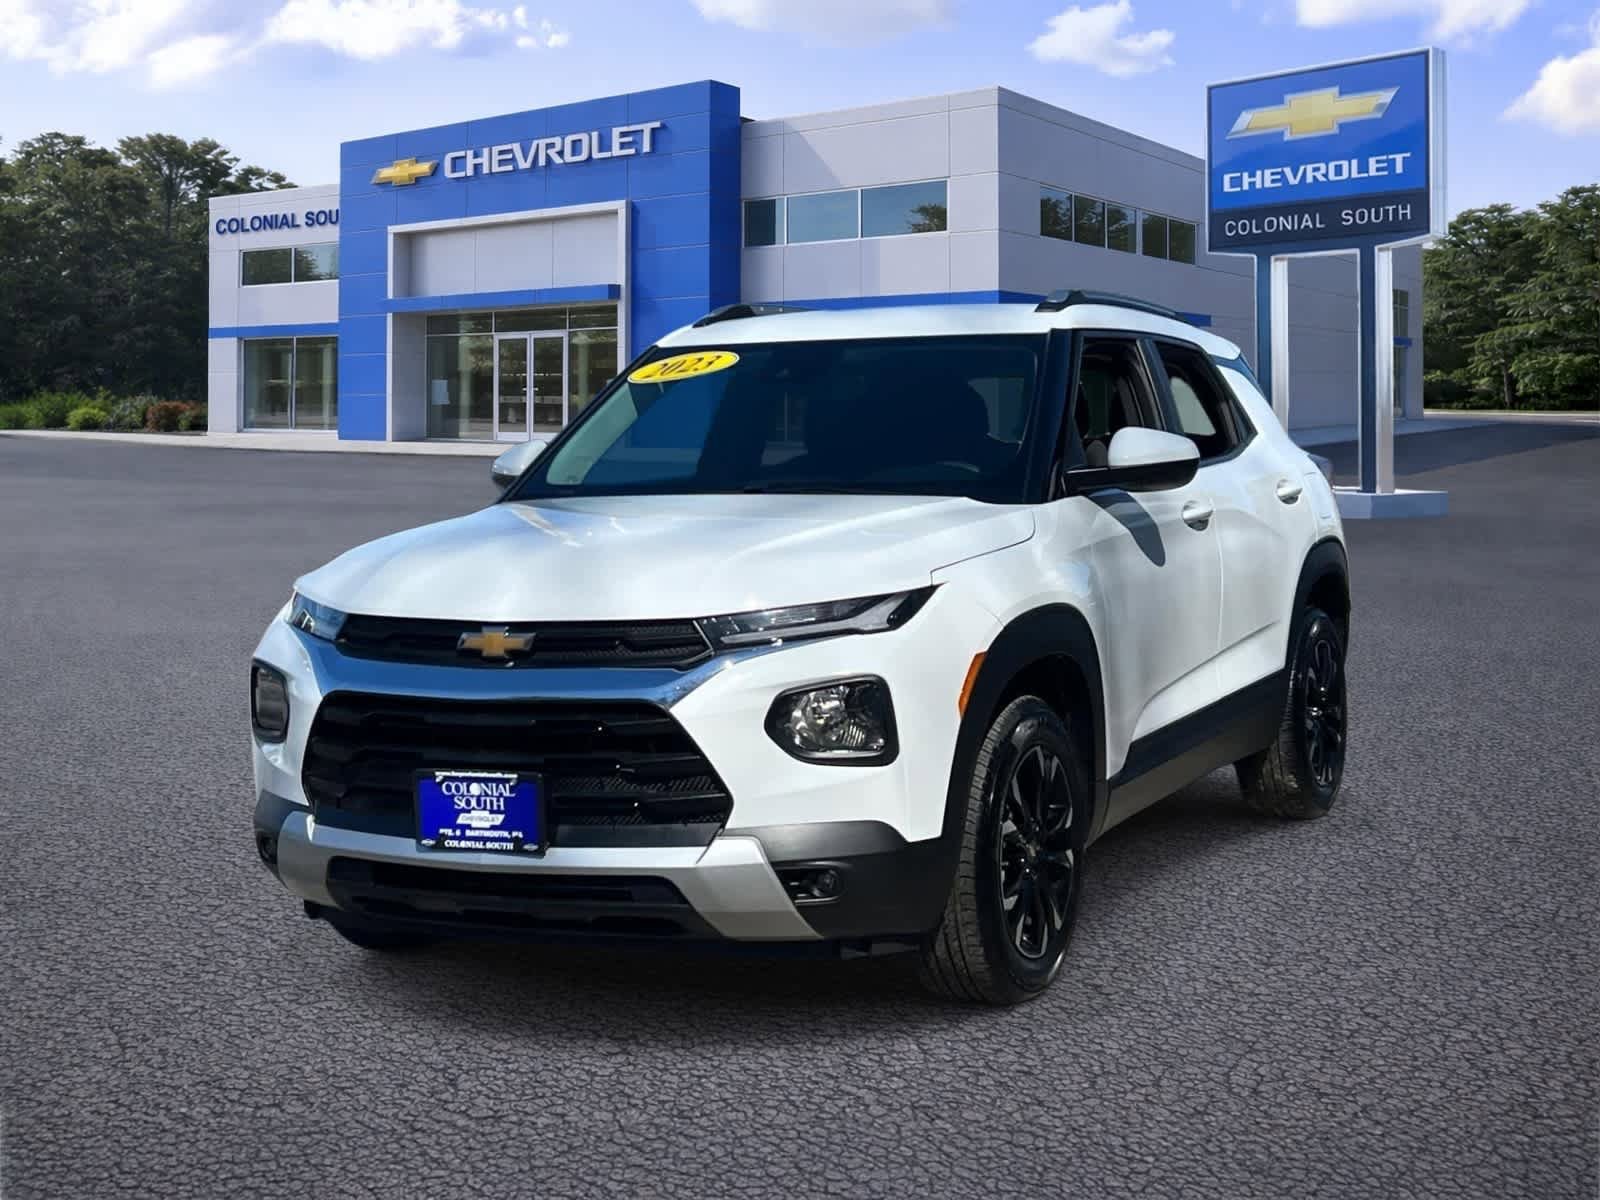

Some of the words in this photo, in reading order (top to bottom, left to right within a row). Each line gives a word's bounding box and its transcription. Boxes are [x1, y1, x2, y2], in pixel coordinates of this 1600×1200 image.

[444, 121, 663, 180] CHEVROLET
[1223, 152, 1411, 193] CHEVROLET
[215, 212, 301, 235] COLONIAL
[304, 208, 340, 228] SOU
[1225, 212, 1325, 237] COLONIAL
[1341, 203, 1412, 226] SOUTH
[640, 355, 723, 379] 2023
[442, 782, 516, 797] COLONIAL
[454, 797, 505, 811] SOUTH
[461, 815, 500, 823] CHEVROLET
[444, 839, 485, 849] COLONIAL
[485, 841, 514, 850] SOUTH
